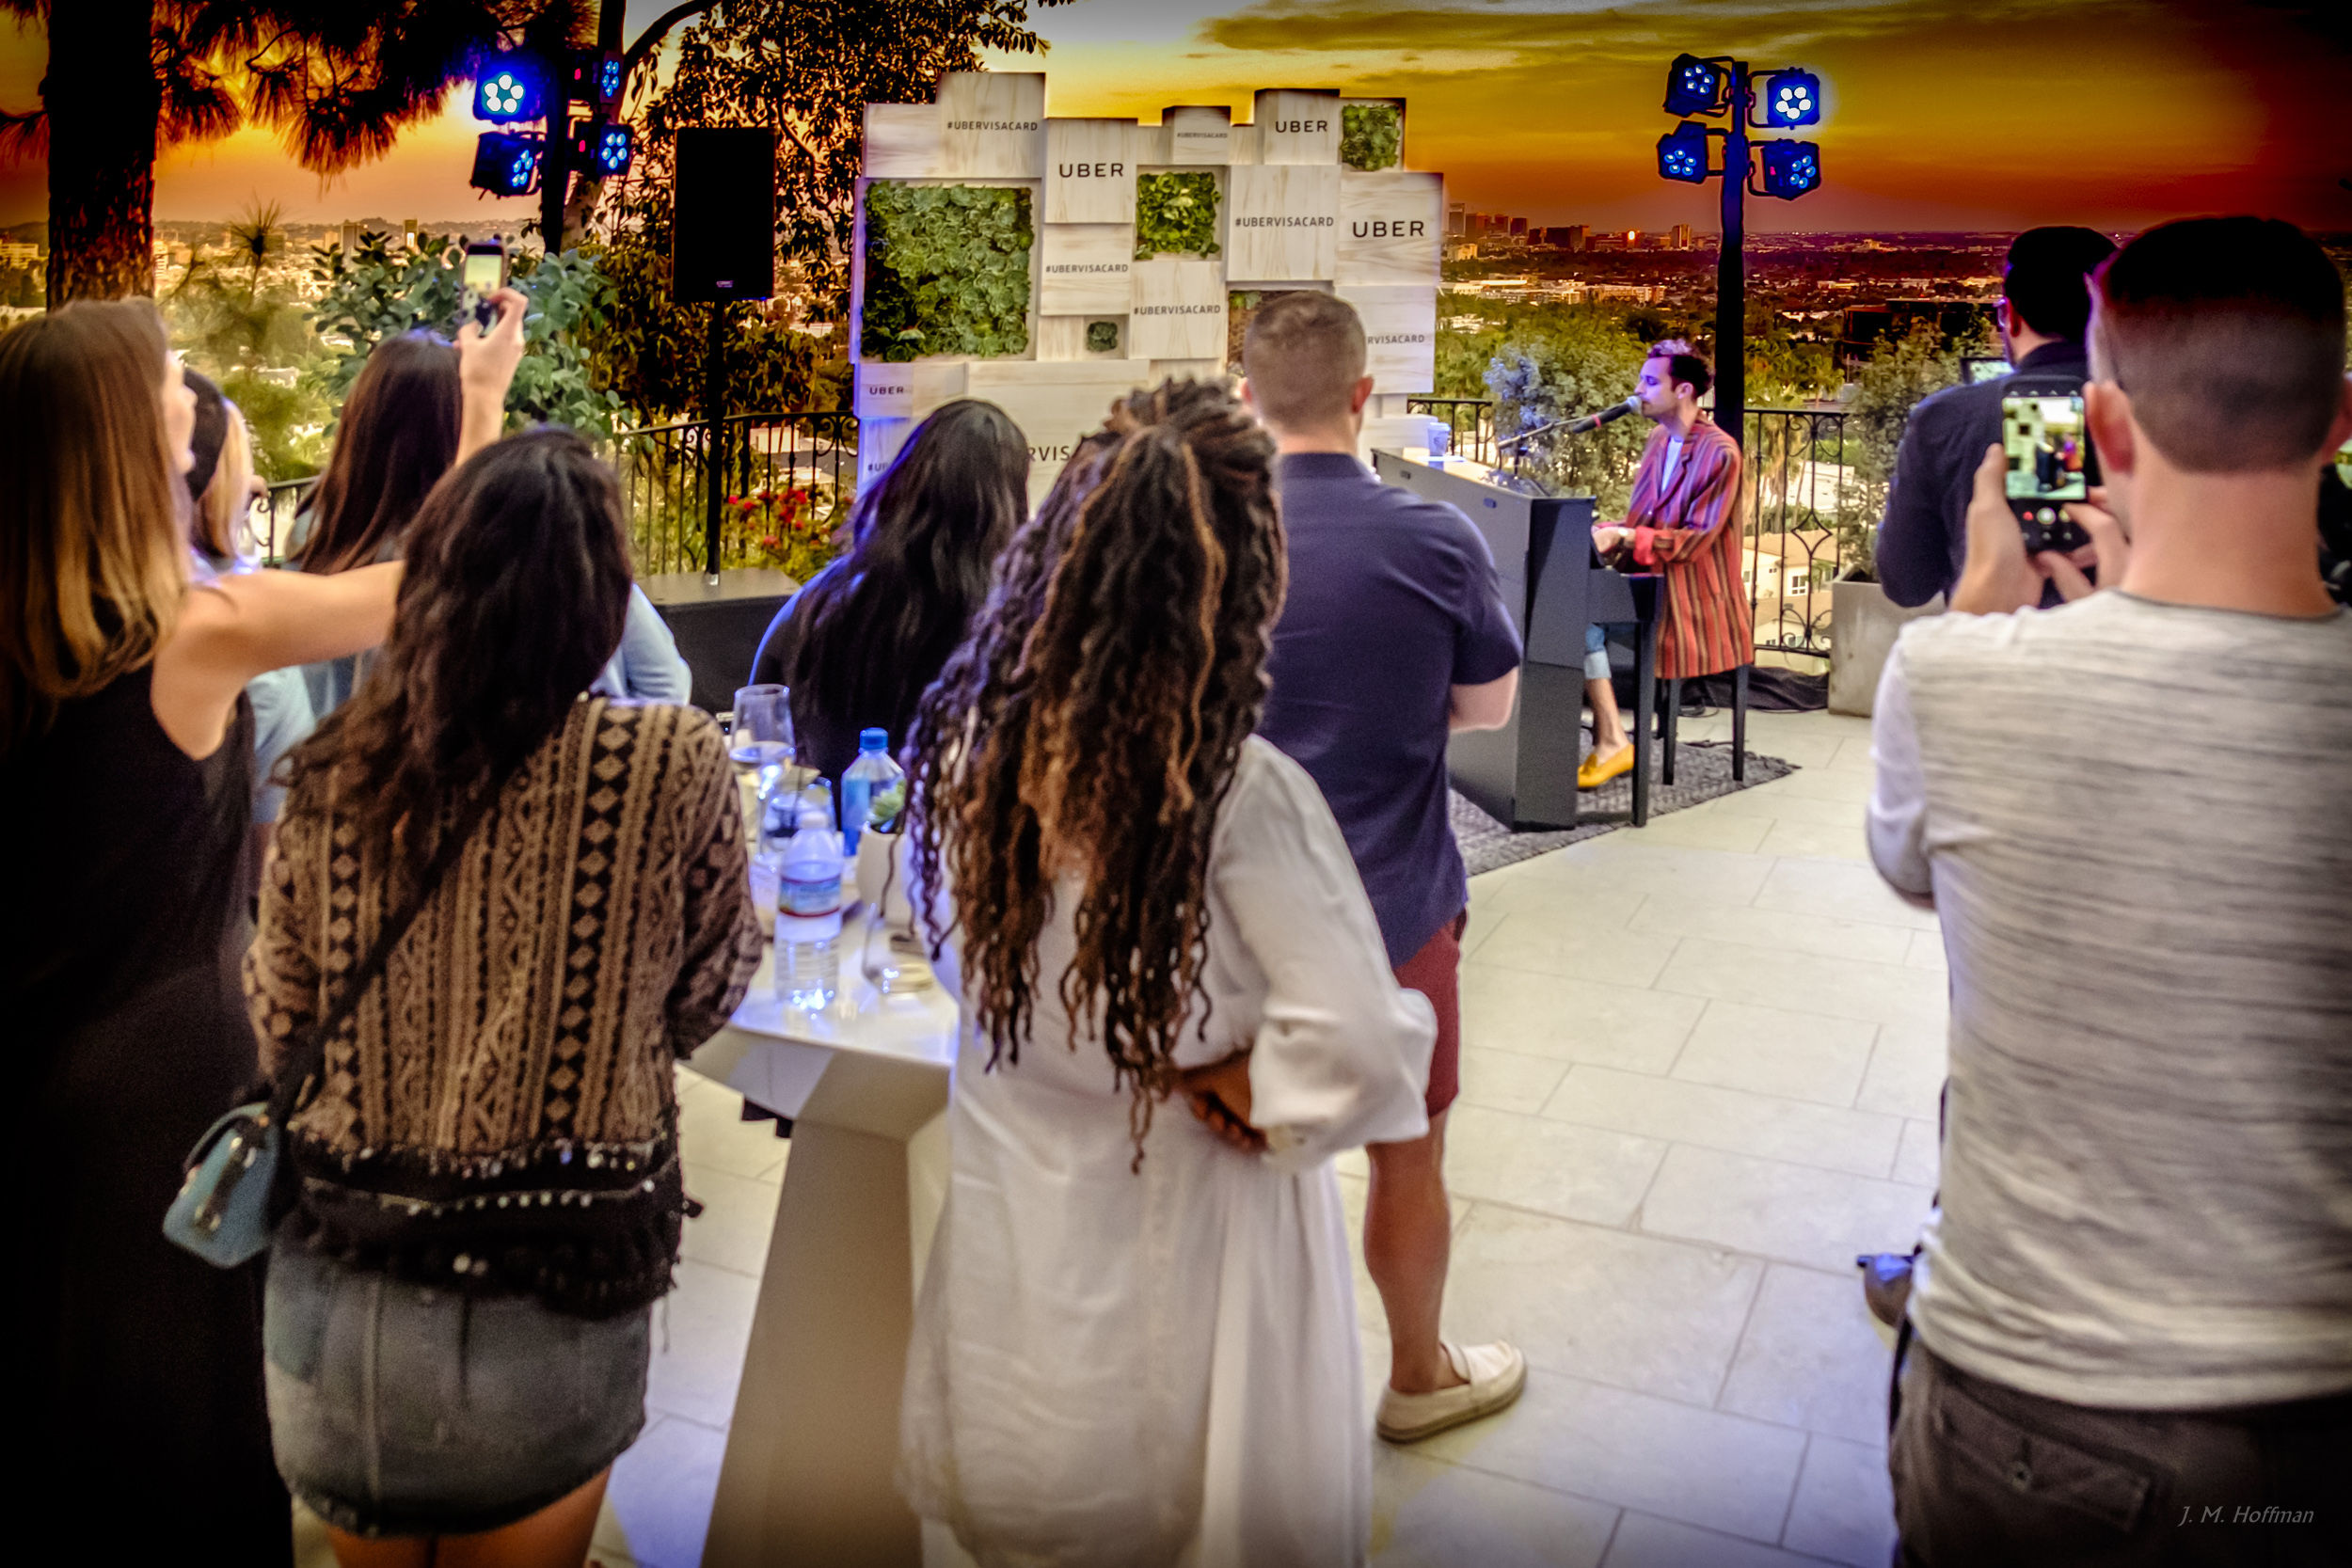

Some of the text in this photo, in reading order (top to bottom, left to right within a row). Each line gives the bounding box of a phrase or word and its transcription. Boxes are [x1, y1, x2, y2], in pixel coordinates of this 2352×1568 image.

[946, 120, 1039, 132] #UBERVISACARD
[1275, 119, 1328, 134] UBER
[1058, 162, 1124, 179] UBER
[1234, 215, 1334, 228] #UBERVISACARD
[1352, 220, 1424, 238] UBER
[1045, 263, 1129, 274] #UBERVISACARD
[1134, 304, 1221, 316] #UBERVISACARD
[1368, 334, 1425, 344] RVISACARD
[869, 386, 904, 395] UBER
